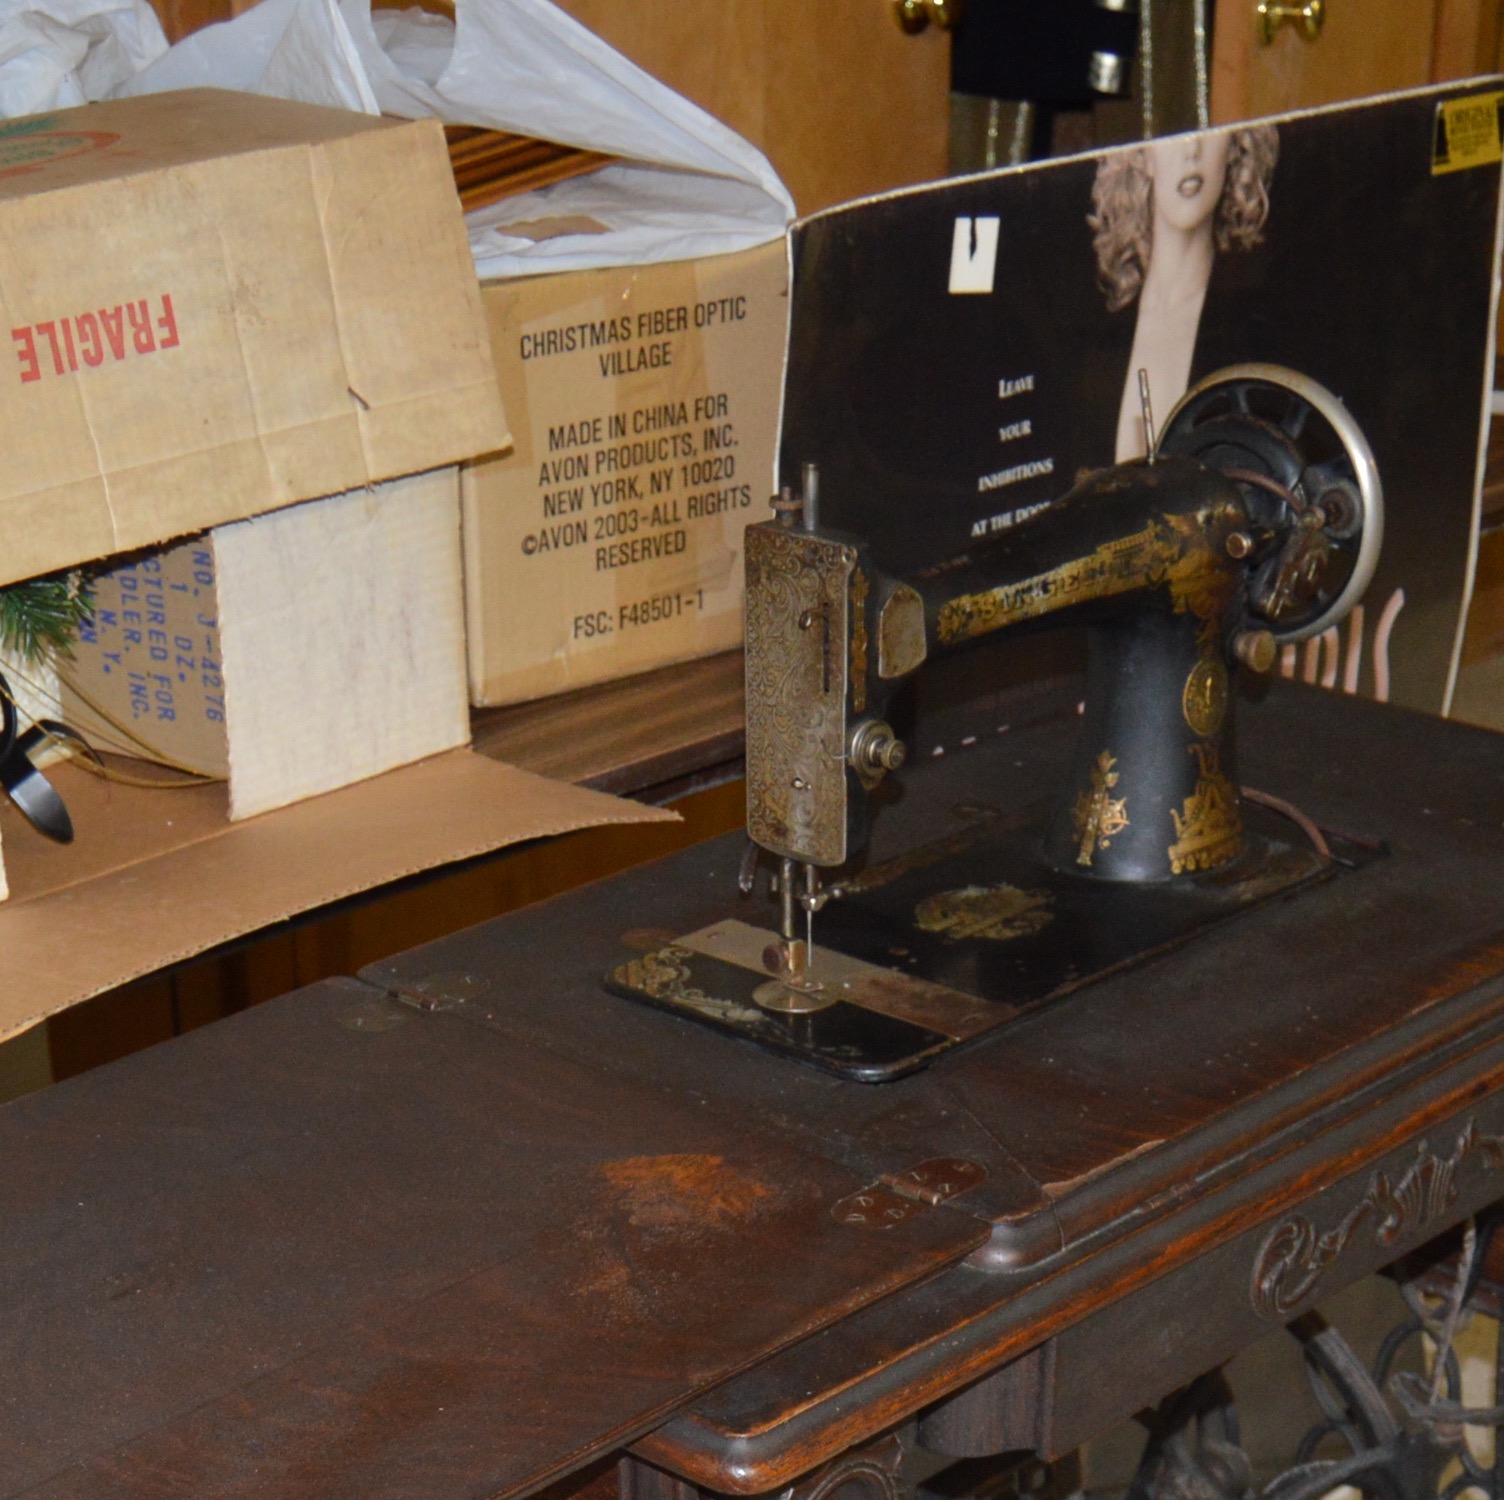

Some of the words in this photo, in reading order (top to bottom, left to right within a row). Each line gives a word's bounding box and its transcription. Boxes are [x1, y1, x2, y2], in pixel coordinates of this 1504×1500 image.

[11, 293, 180, 383] FRAGILE
[520, 316, 631, 360] CHRISTMAS
[637, 307, 688, 338] FIBER
[694, 296, 746, 328] OPTIC
[599, 341, 672, 377] VILLAGE
[548, 418, 602, 451] MADE
[608, 412, 626, 439] IN
[633, 402, 688, 434] CHINA
[694, 393, 728, 421] FOR
[538, 454, 589, 487] AVON
[596, 432, 698, 474] PRODUCTS,
[703, 424, 739, 451] INC.
[543, 487, 584, 518] NEW
[591, 475, 644, 507] YORK,
[650, 469, 675, 495] NY
[682, 455, 735, 487] 10020
[594, 500, 681, 540] 2003-ALL
[687, 484, 751, 519] RIGHTS
[971, 519, 987, 537] AT
[192, 549, 214, 597] NO.
[596, 530, 686, 572] RESERVED
[573, 611, 613, 639] FSC:
[619, 589, 704, 630] F48501-1
[127, 671, 150, 719] INC.
[153, 673, 177, 721] FOR
